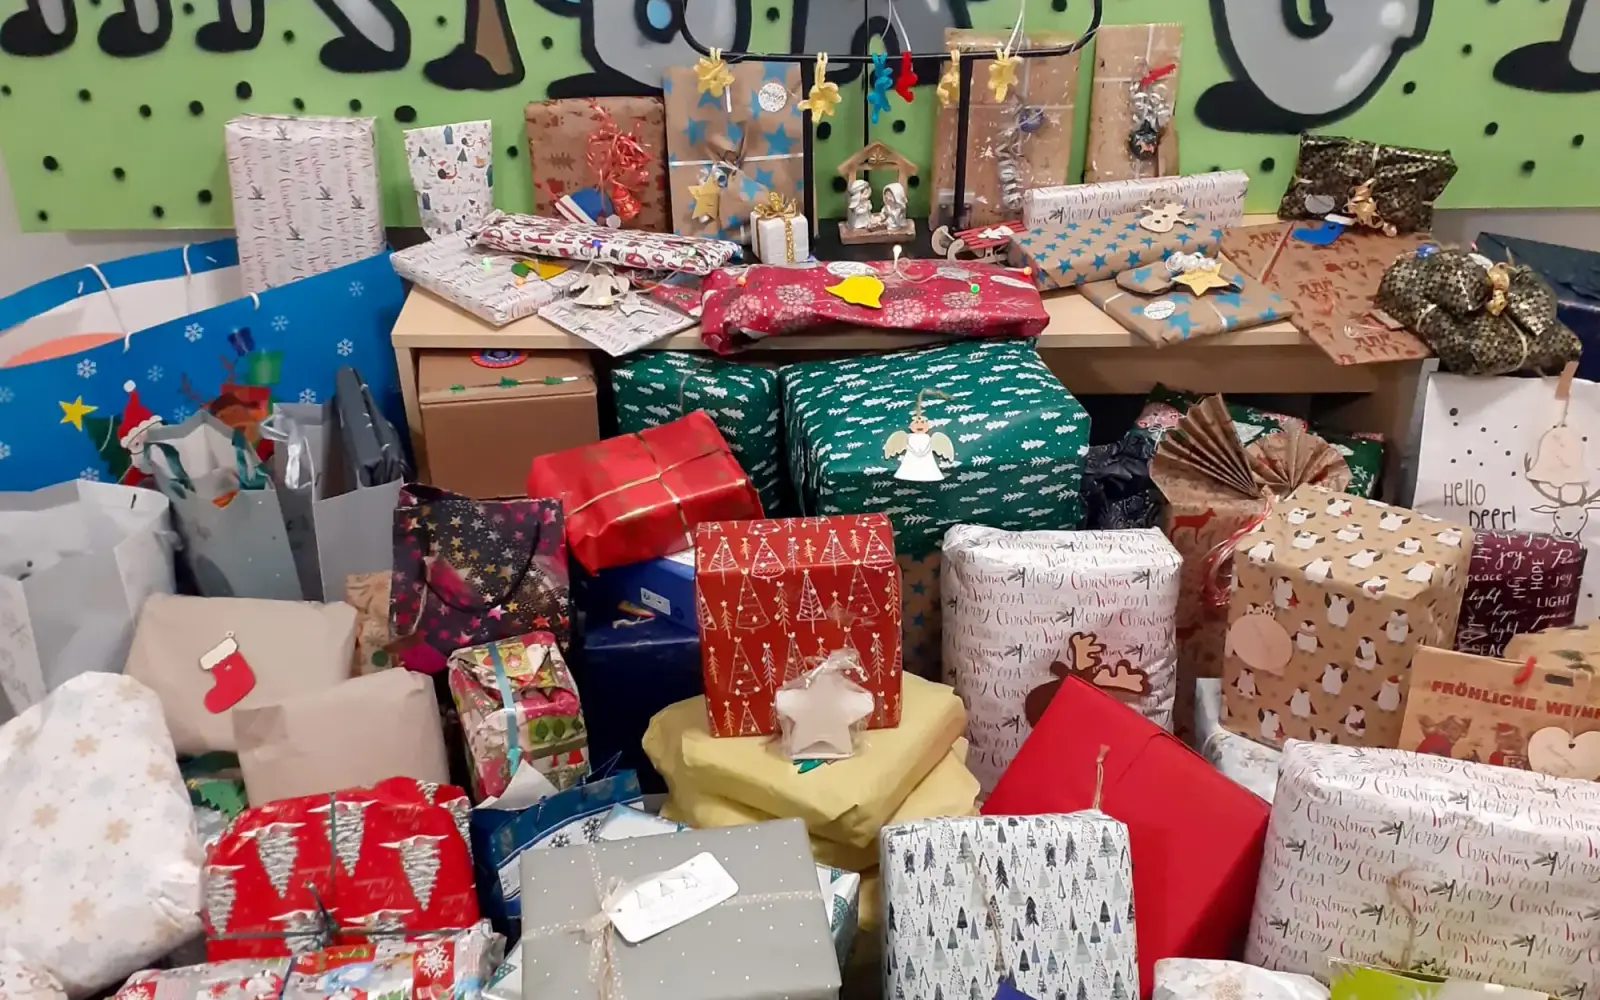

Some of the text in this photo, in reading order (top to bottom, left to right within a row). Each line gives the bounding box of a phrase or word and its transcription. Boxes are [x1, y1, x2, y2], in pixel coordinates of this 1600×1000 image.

[1443, 479, 1486, 507] Hello
[1531, 559, 1544, 590] HOPE
[1536, 595, 1571, 608] LIGHT
[1431, 681, 1538, 711] FRÖHLICHE
